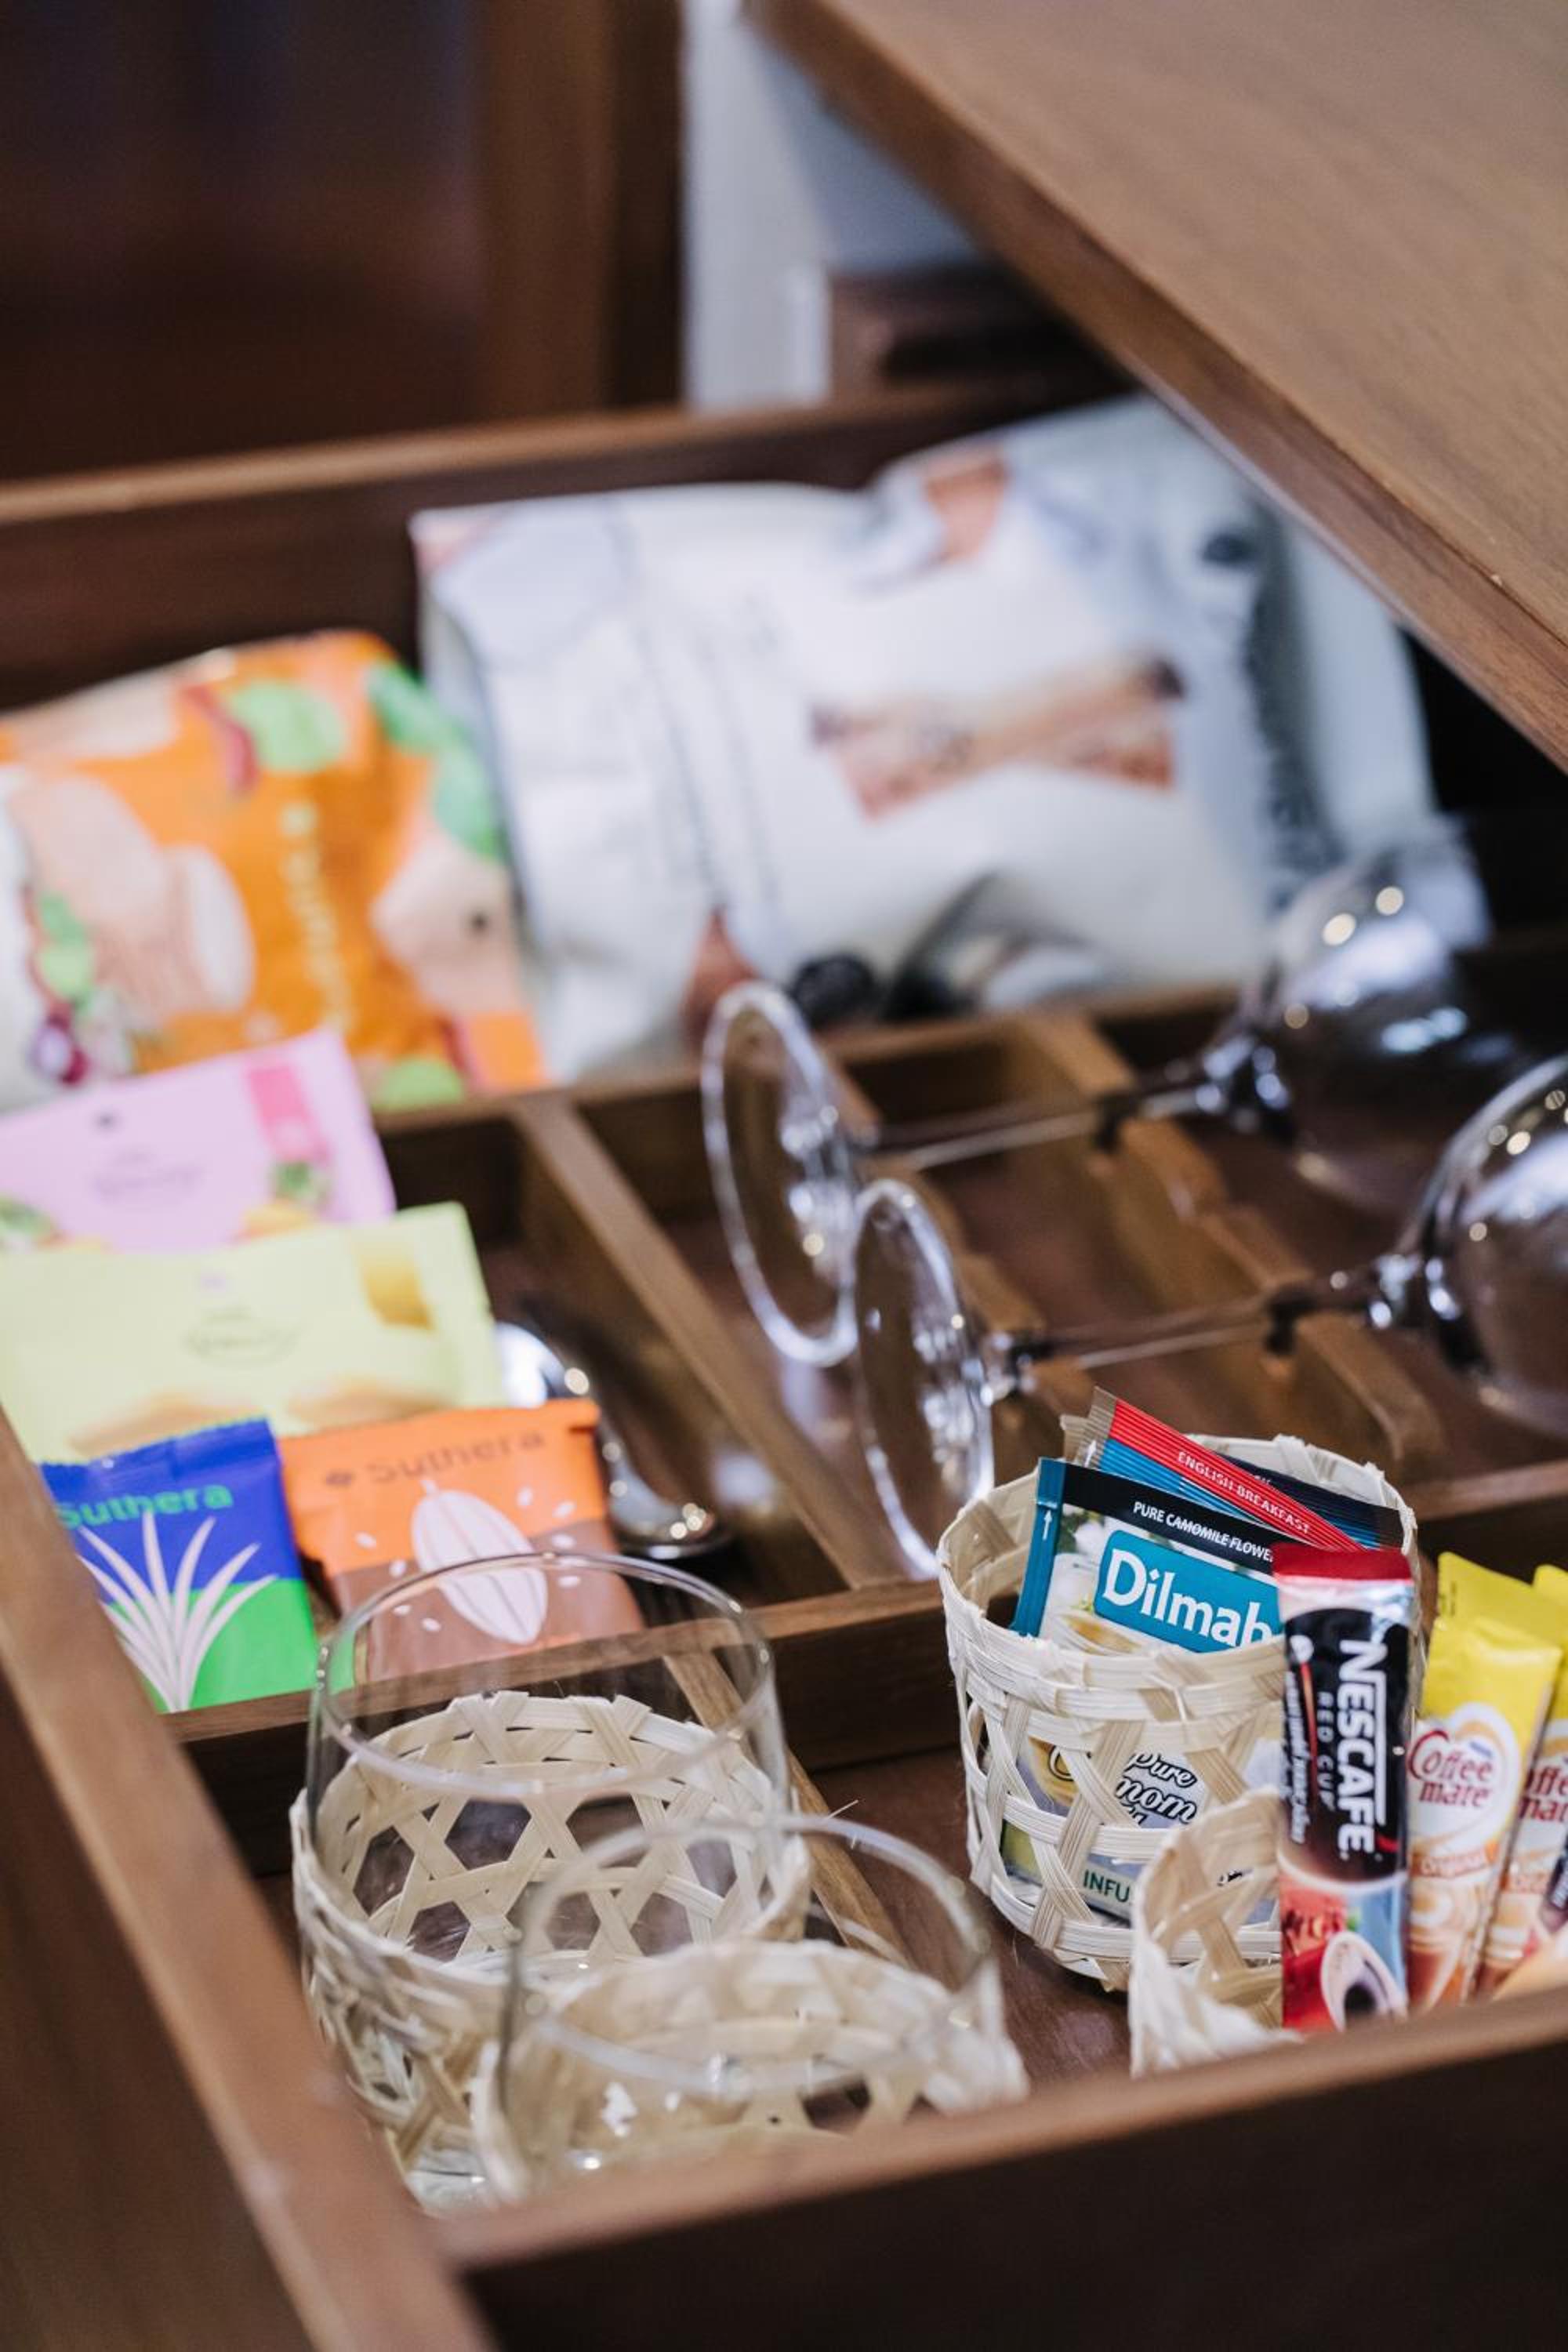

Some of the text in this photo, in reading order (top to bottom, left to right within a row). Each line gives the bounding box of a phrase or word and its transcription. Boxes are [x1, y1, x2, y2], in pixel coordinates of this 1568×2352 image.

[54, 1484, 234, 1530] Suthera
[1178, 1451, 1310, 1534] ENGLISH BREAKFAST
[1133, 1501, 1274, 1563] PURE CAMOMILE FLOWE
[1102, 1548, 1272, 1647] Dilmah
[1316, 1690, 1335, 1812] RED CUP
[1406, 1730, 1493, 1782] Coffee
[1083, 1869, 1131, 1904] INFU
